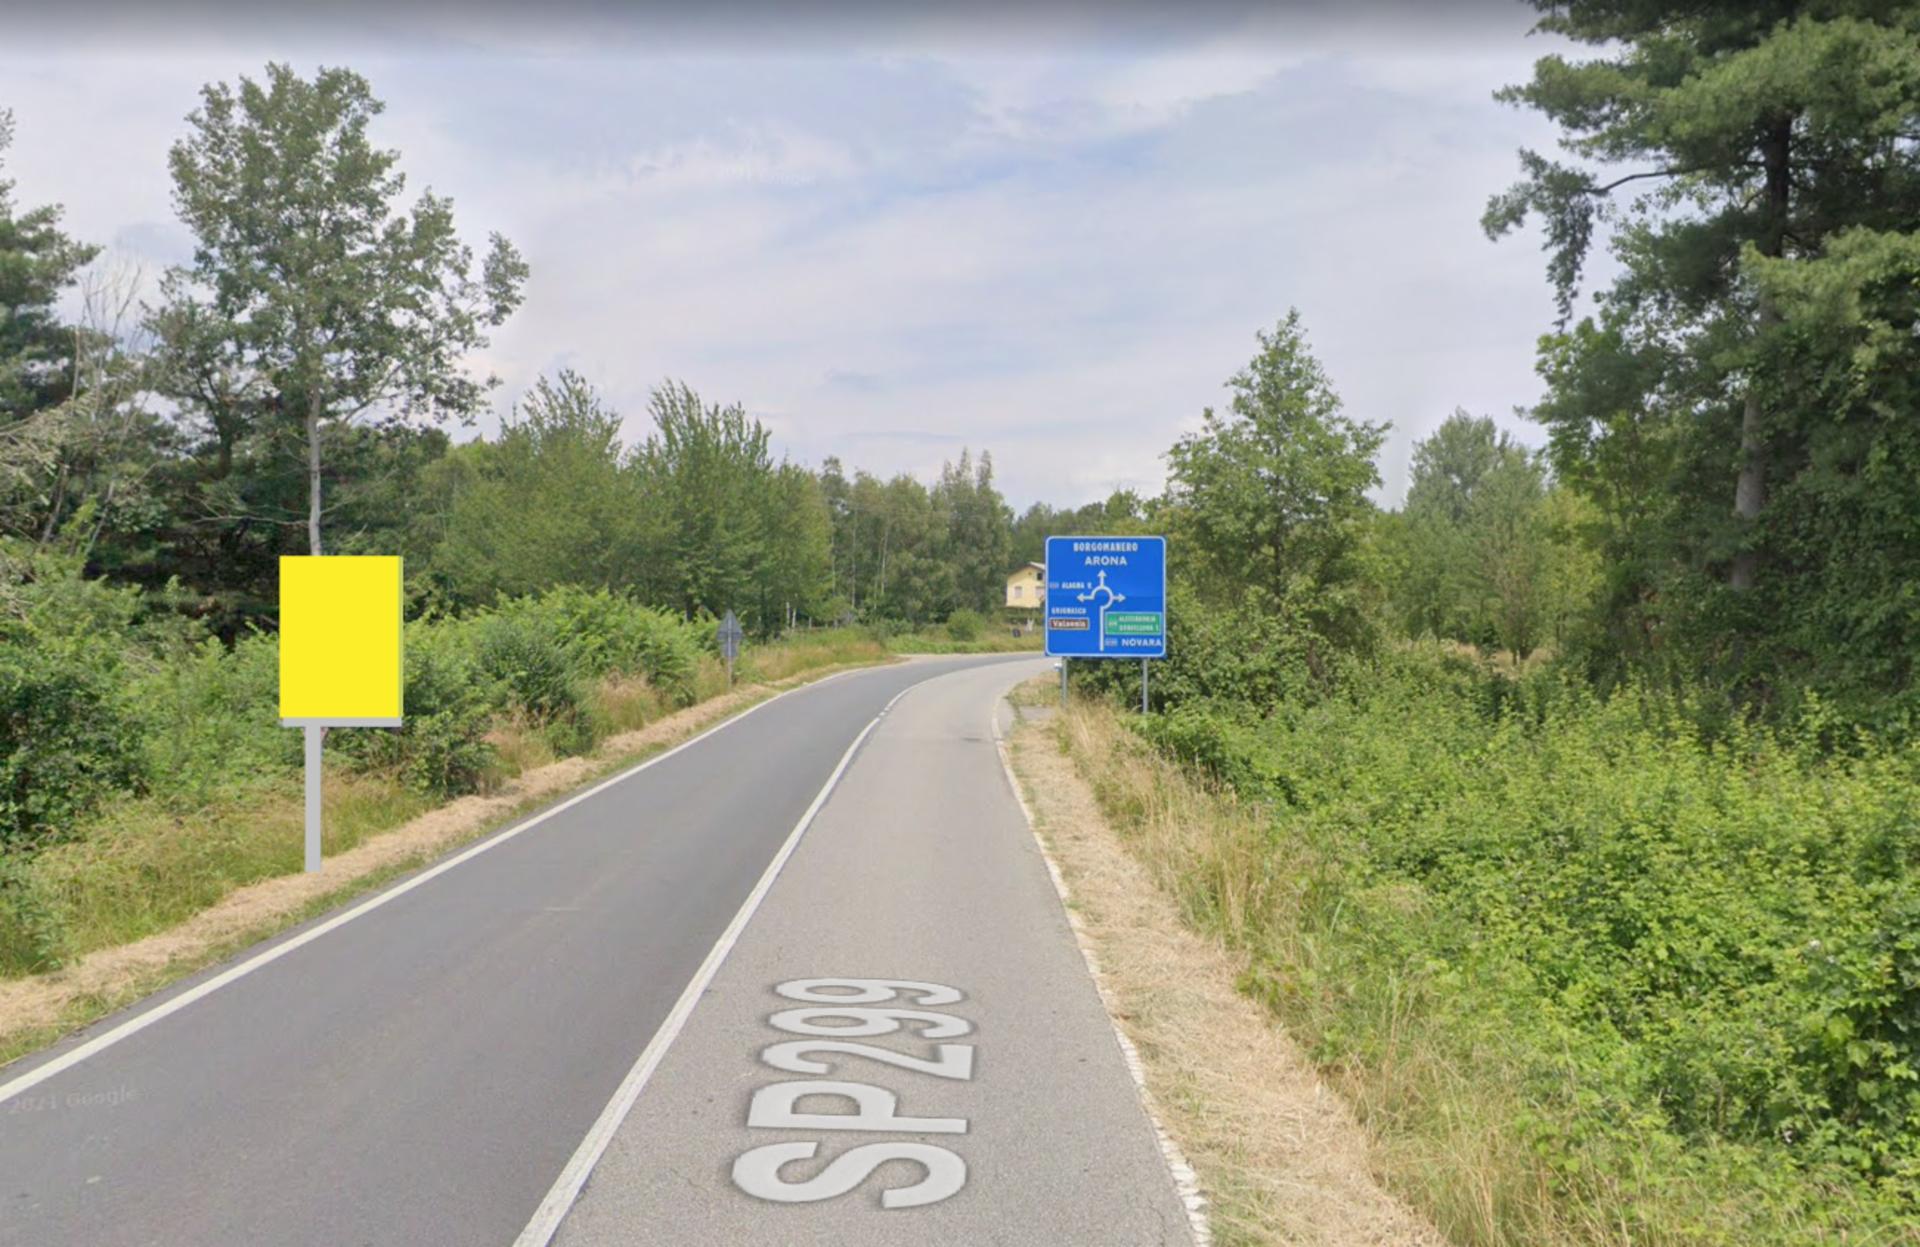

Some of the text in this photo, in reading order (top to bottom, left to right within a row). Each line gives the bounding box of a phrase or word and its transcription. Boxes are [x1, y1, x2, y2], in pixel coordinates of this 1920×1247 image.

[1073, 542, 1138, 552] BORGOMANERO
[1084, 556, 1128, 566] ARONA
[1121, 637, 1162, 647] NOVARA
